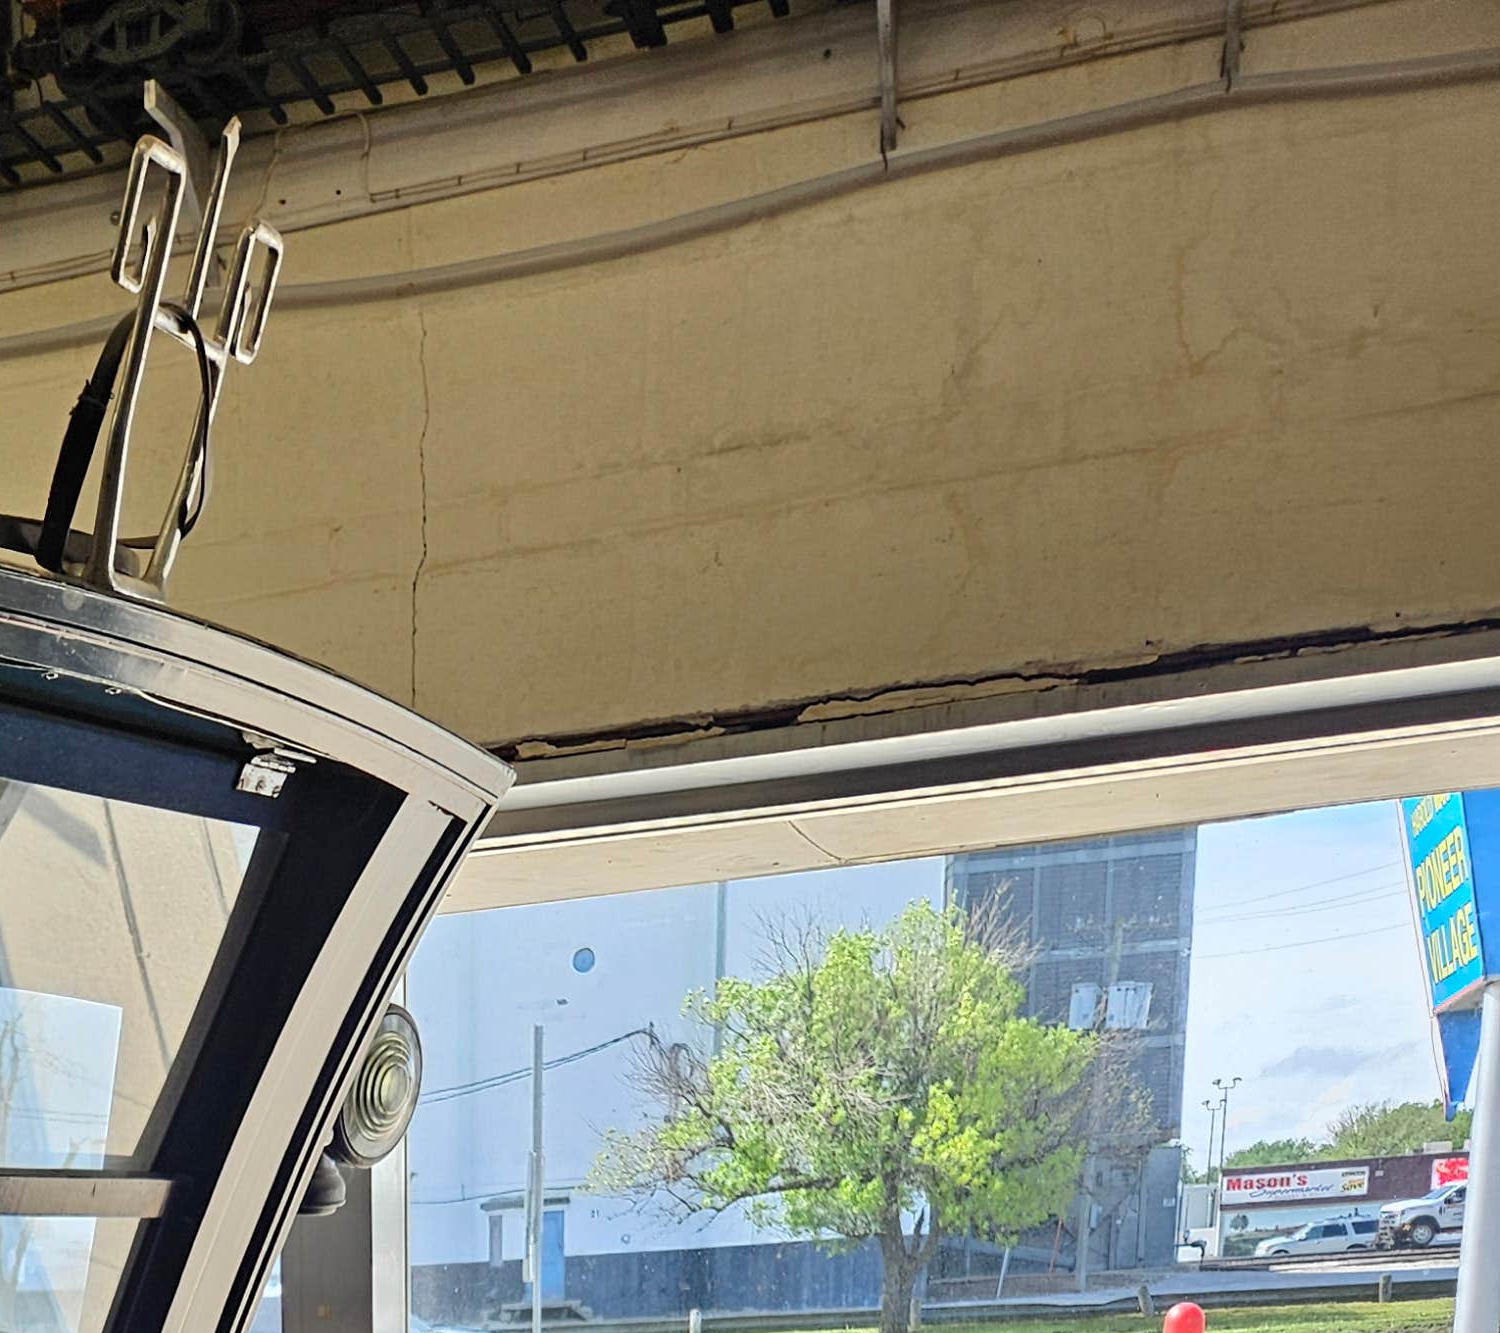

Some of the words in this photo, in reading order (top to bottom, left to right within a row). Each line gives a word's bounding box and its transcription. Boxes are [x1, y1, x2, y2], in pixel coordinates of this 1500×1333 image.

[1415, 825, 1470, 919] PIONEER
[1427, 902, 1479, 985] VILLAGE
[1226, 1173, 1308, 1191] Mason's
